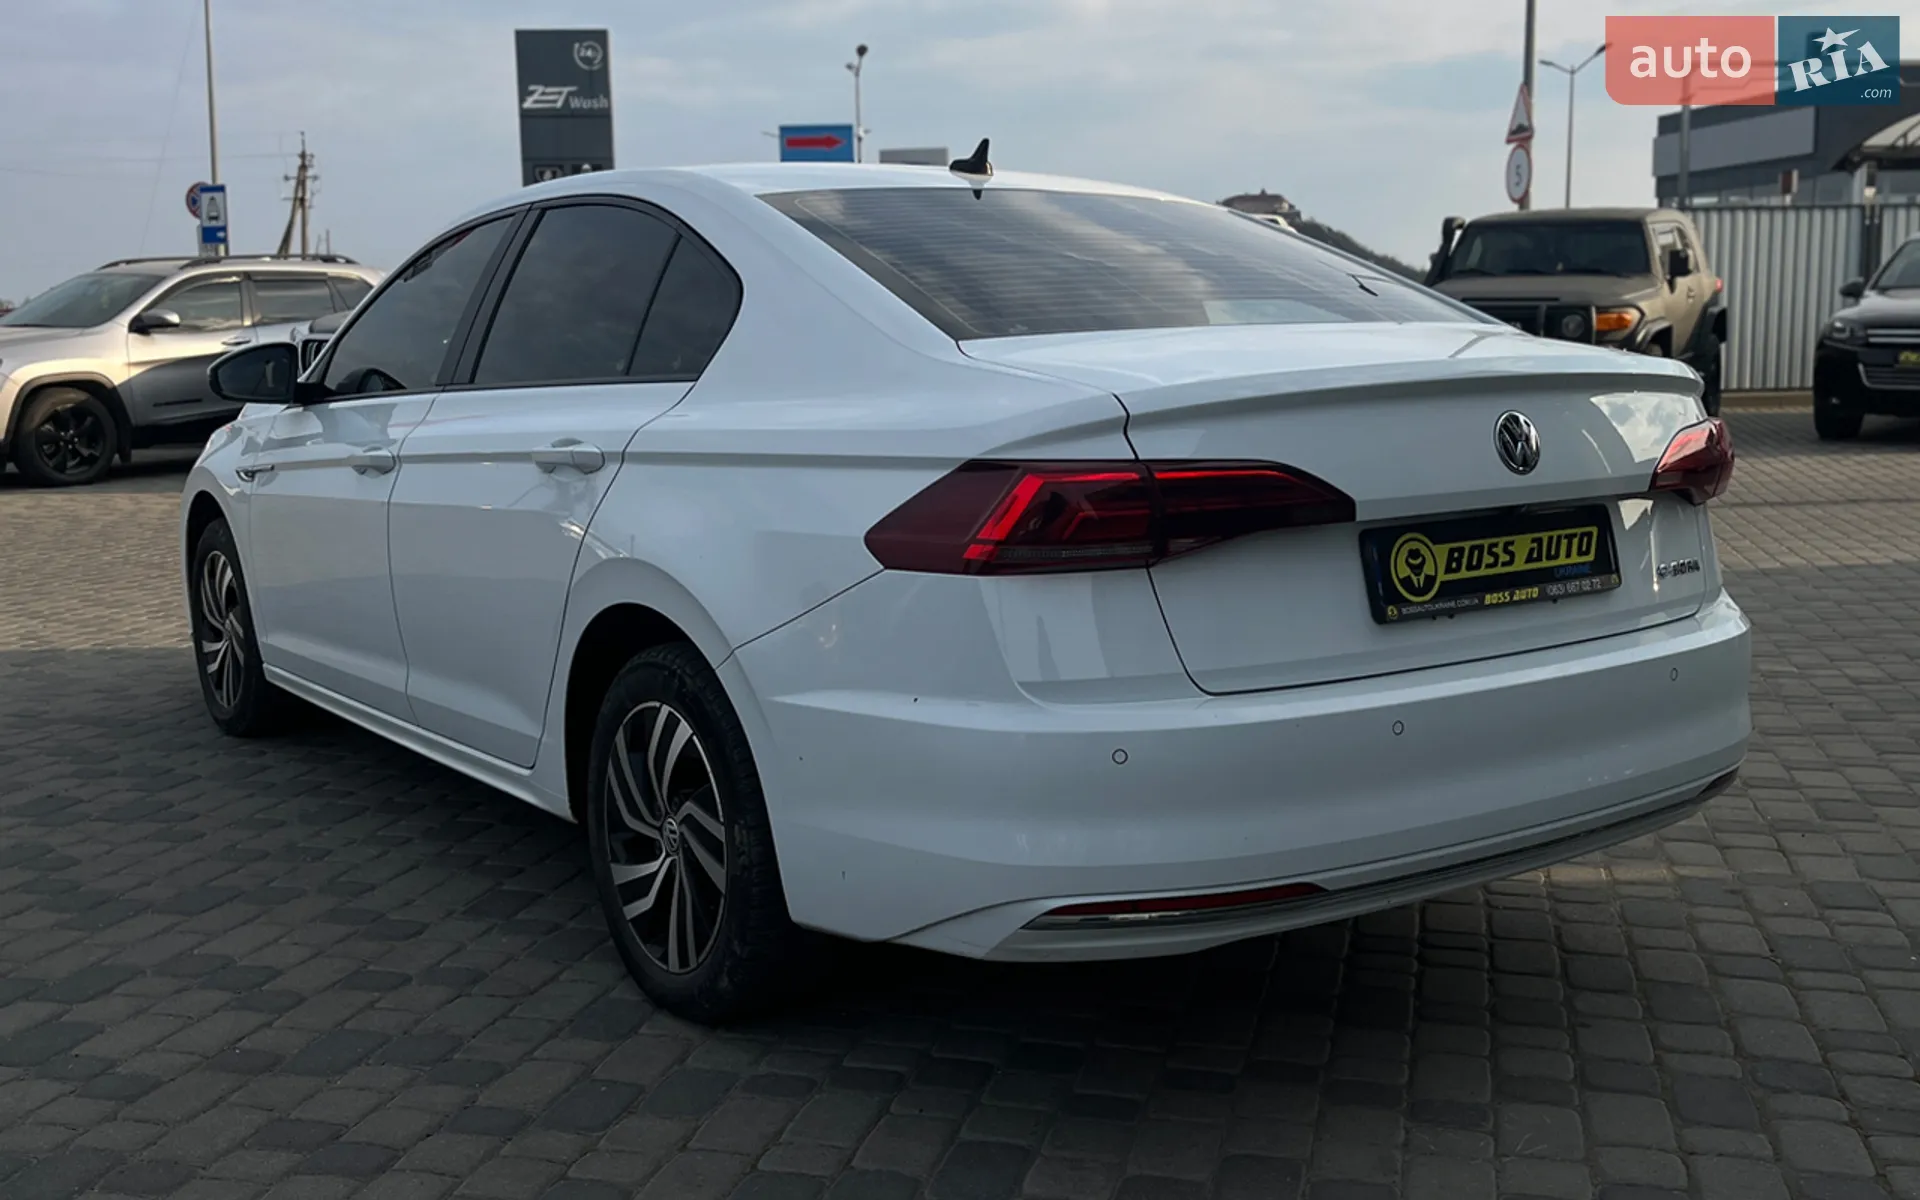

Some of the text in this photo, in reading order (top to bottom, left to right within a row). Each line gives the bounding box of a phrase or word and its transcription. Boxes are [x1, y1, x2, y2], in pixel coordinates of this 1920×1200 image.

[522, 84, 609, 109] ZET Wash
[1514, 164, 1523, 187] 5
[1444, 531, 1594, 575] BOSS AUTO
[1484, 591, 1510, 605] BOSS
[1513, 587, 1539, 600] AUTO
